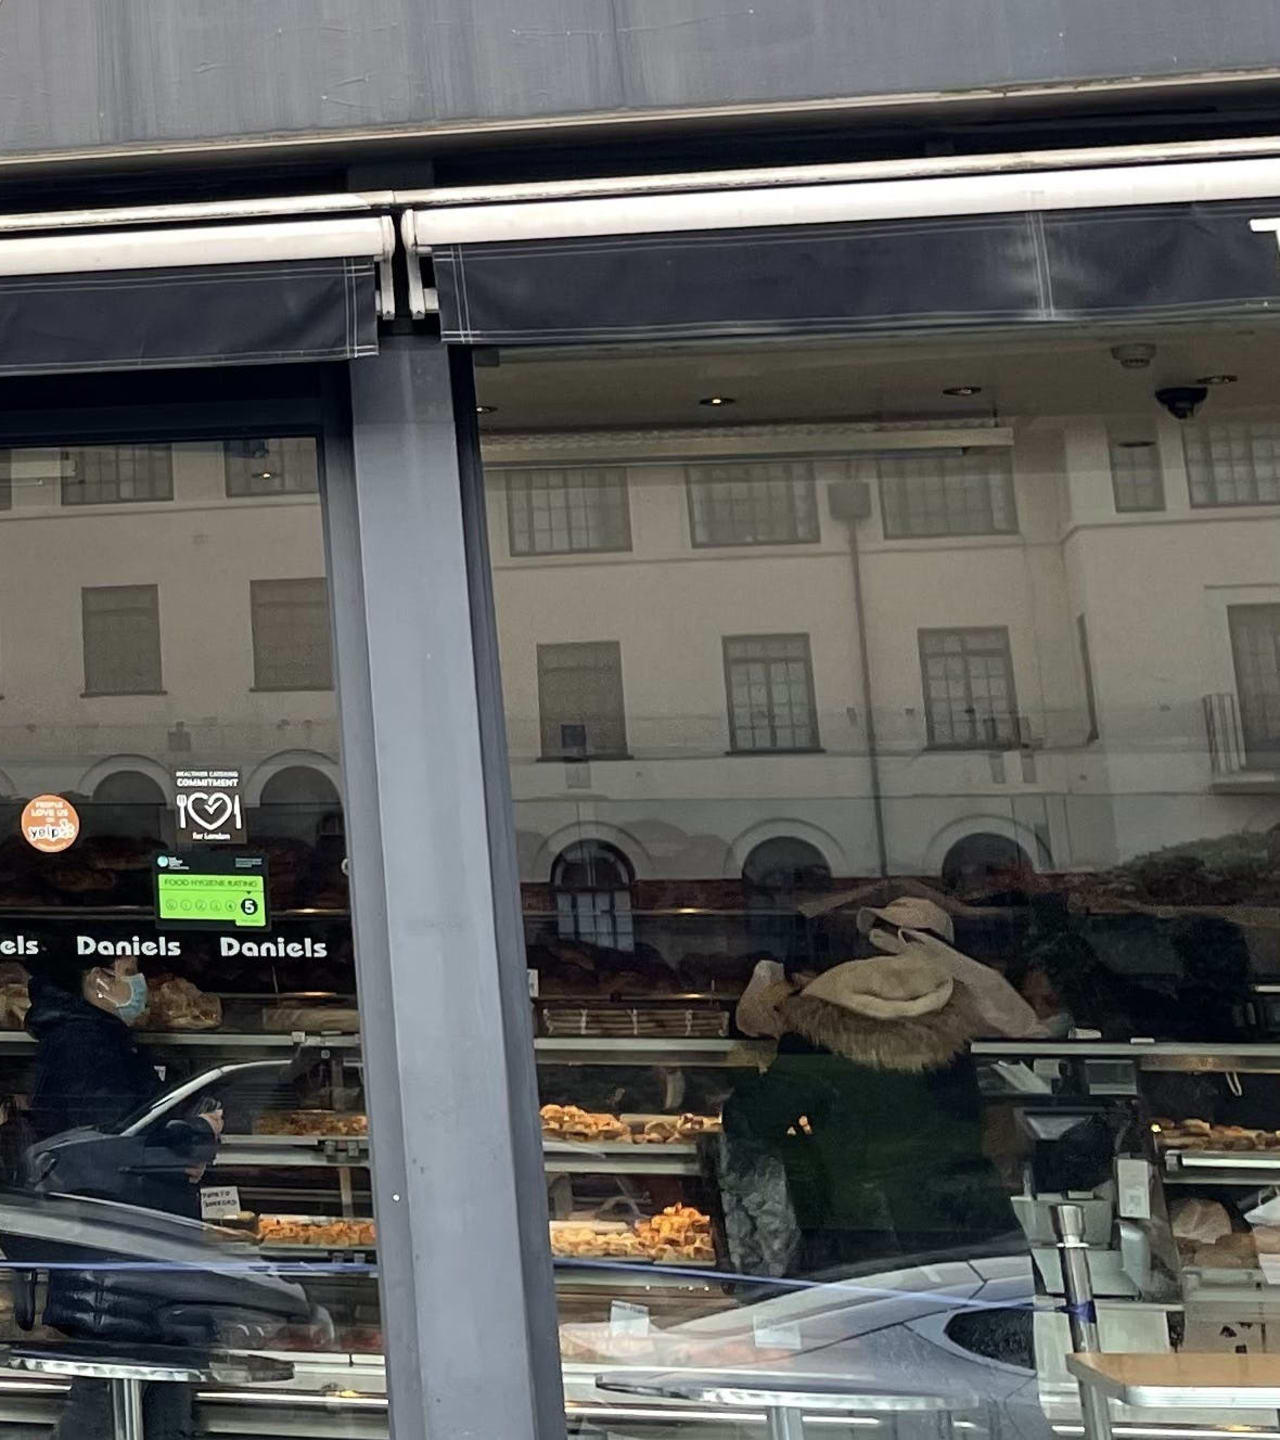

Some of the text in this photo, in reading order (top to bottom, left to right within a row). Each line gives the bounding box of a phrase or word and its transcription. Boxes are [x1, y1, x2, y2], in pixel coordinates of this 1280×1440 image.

[177, 778, 238, 787] COMMITMENT
[164, 878, 190, 886] FOOD
[244, 900, 255, 914] 5
[76, 935, 181, 956] Daniels
[220, 936, 328, 958] Daniels
